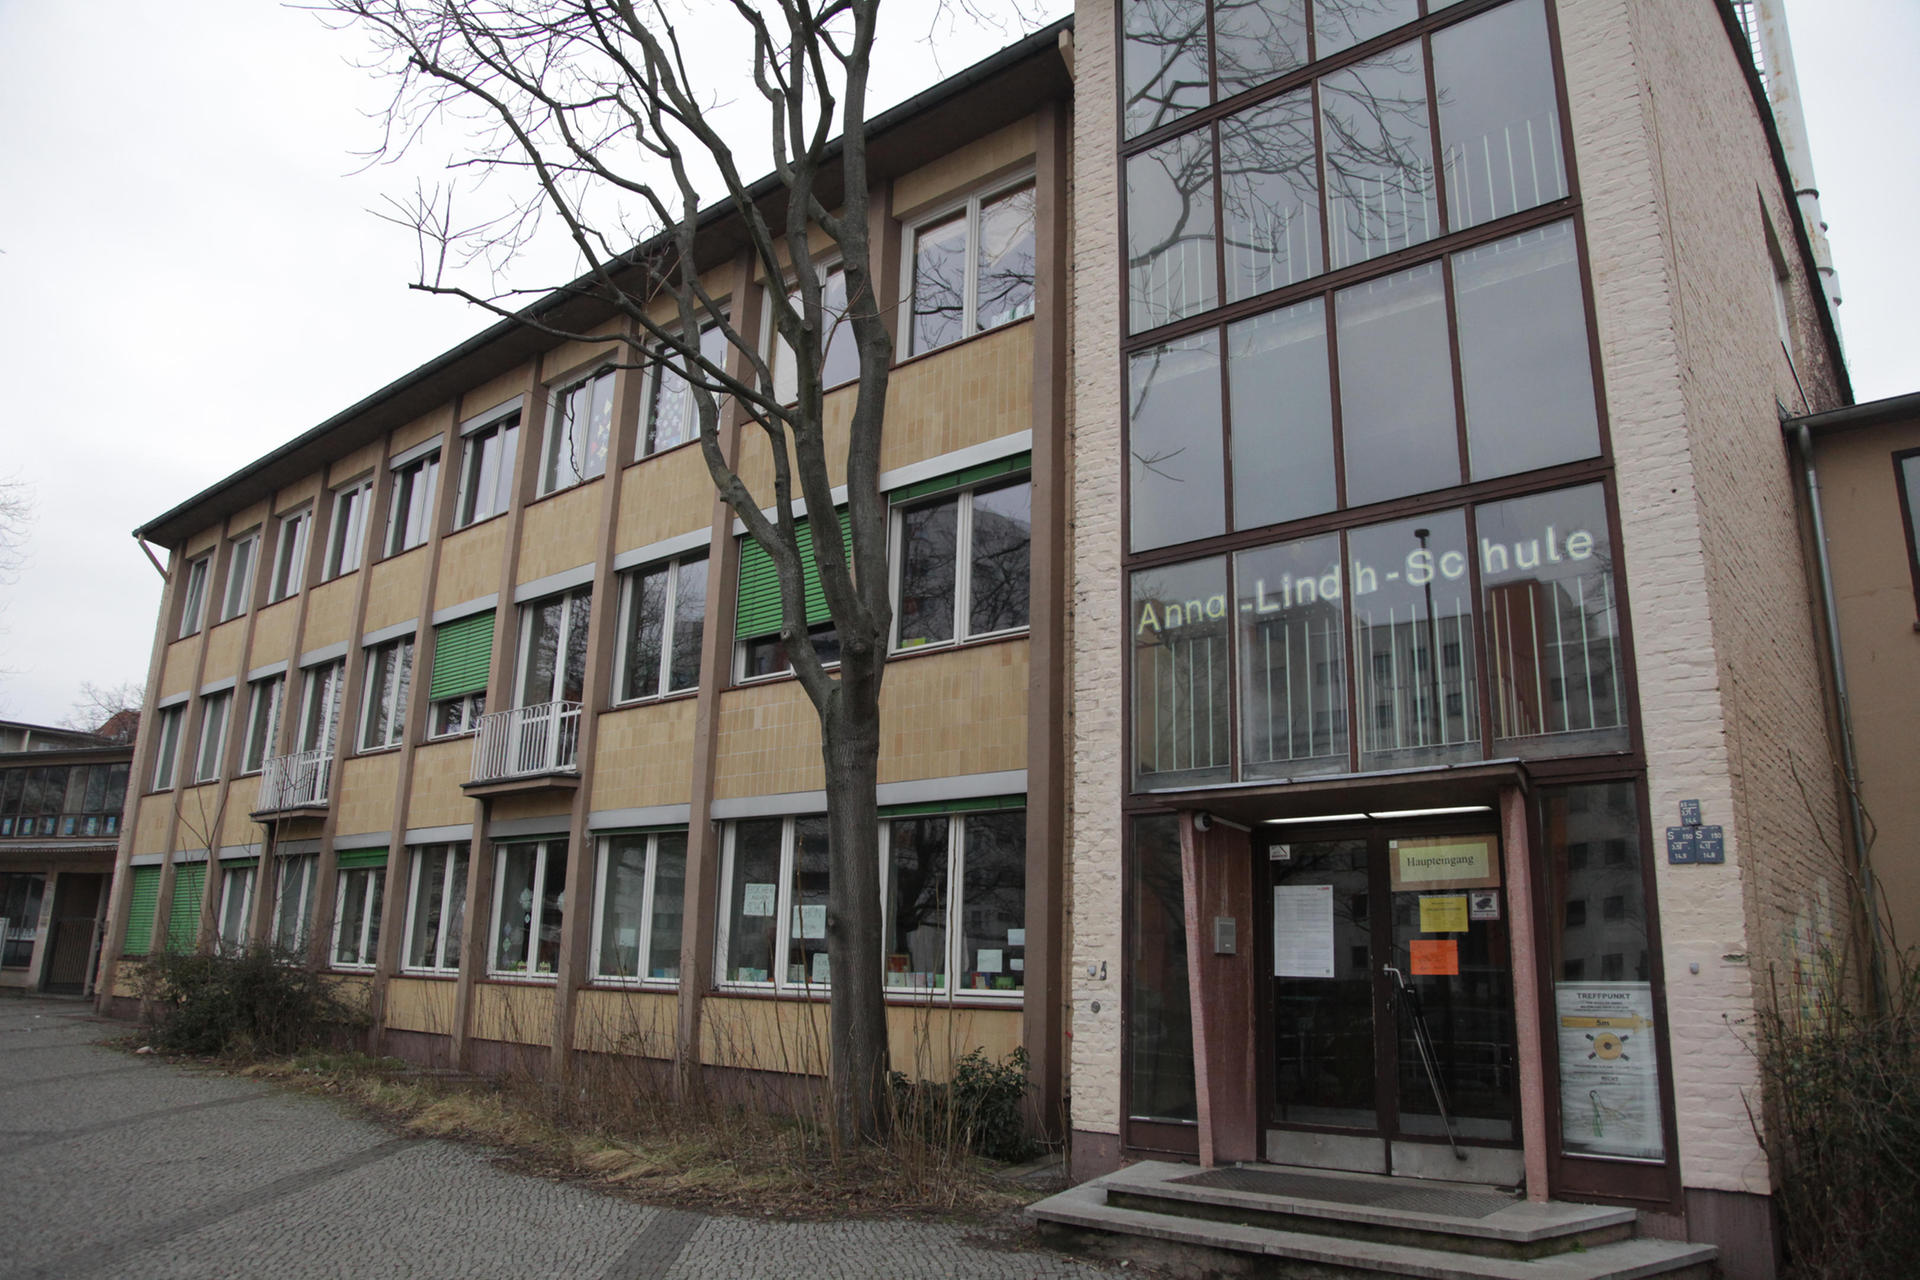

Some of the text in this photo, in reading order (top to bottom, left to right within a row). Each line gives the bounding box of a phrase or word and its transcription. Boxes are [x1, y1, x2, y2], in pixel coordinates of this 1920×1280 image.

[1136, 525, 1595, 635] Anna-Lindh-Schule
[1695, 830, 1703, 839] S
[1407, 855, 1474, 868] Haupteingang
